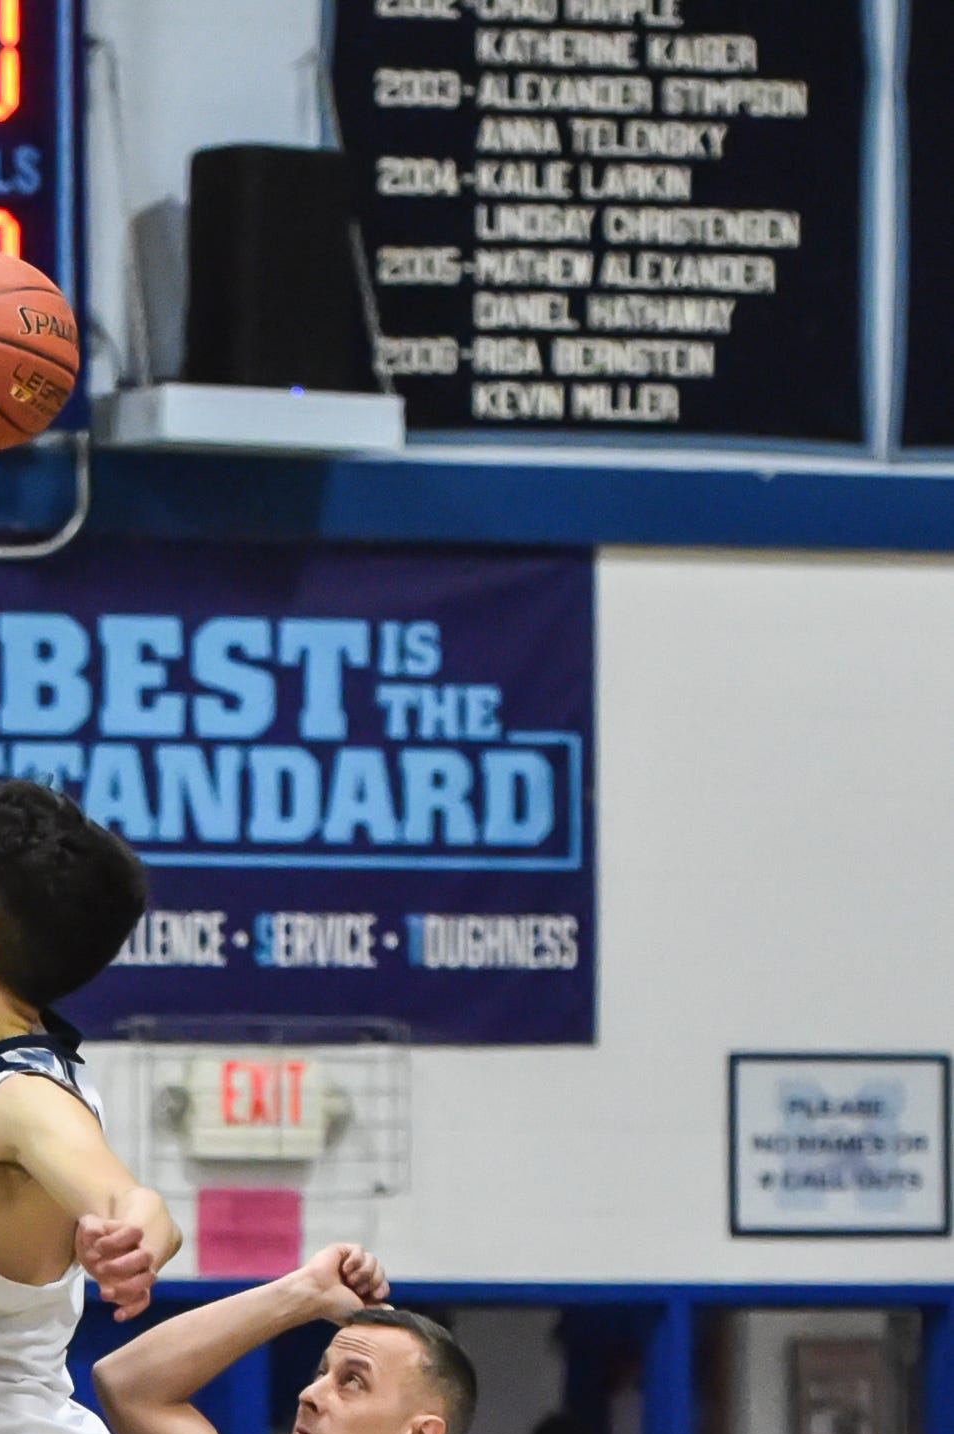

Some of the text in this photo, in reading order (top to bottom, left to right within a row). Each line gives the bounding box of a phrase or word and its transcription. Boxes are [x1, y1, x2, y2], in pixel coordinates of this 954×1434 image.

[476, 116, 561, 154] ANNA
[579, 161, 692, 200] LARKIN
[475, 205, 595, 241] LINDSAY
[599, 251, 776, 294] ALEXANDER
[473, 292, 580, 330] DANIEL
[551, 337, 714, 378] BERNSTEIN
[472, 382, 679, 422] KEVIN MILLER
[379, 620, 442, 677] IS
[375, 683, 503, 741] THE
[253, 911, 378, 968] SERVICE
[405, 912, 579, 970] TOUGHNESS
[221, 1060, 306, 1126] EXIT
